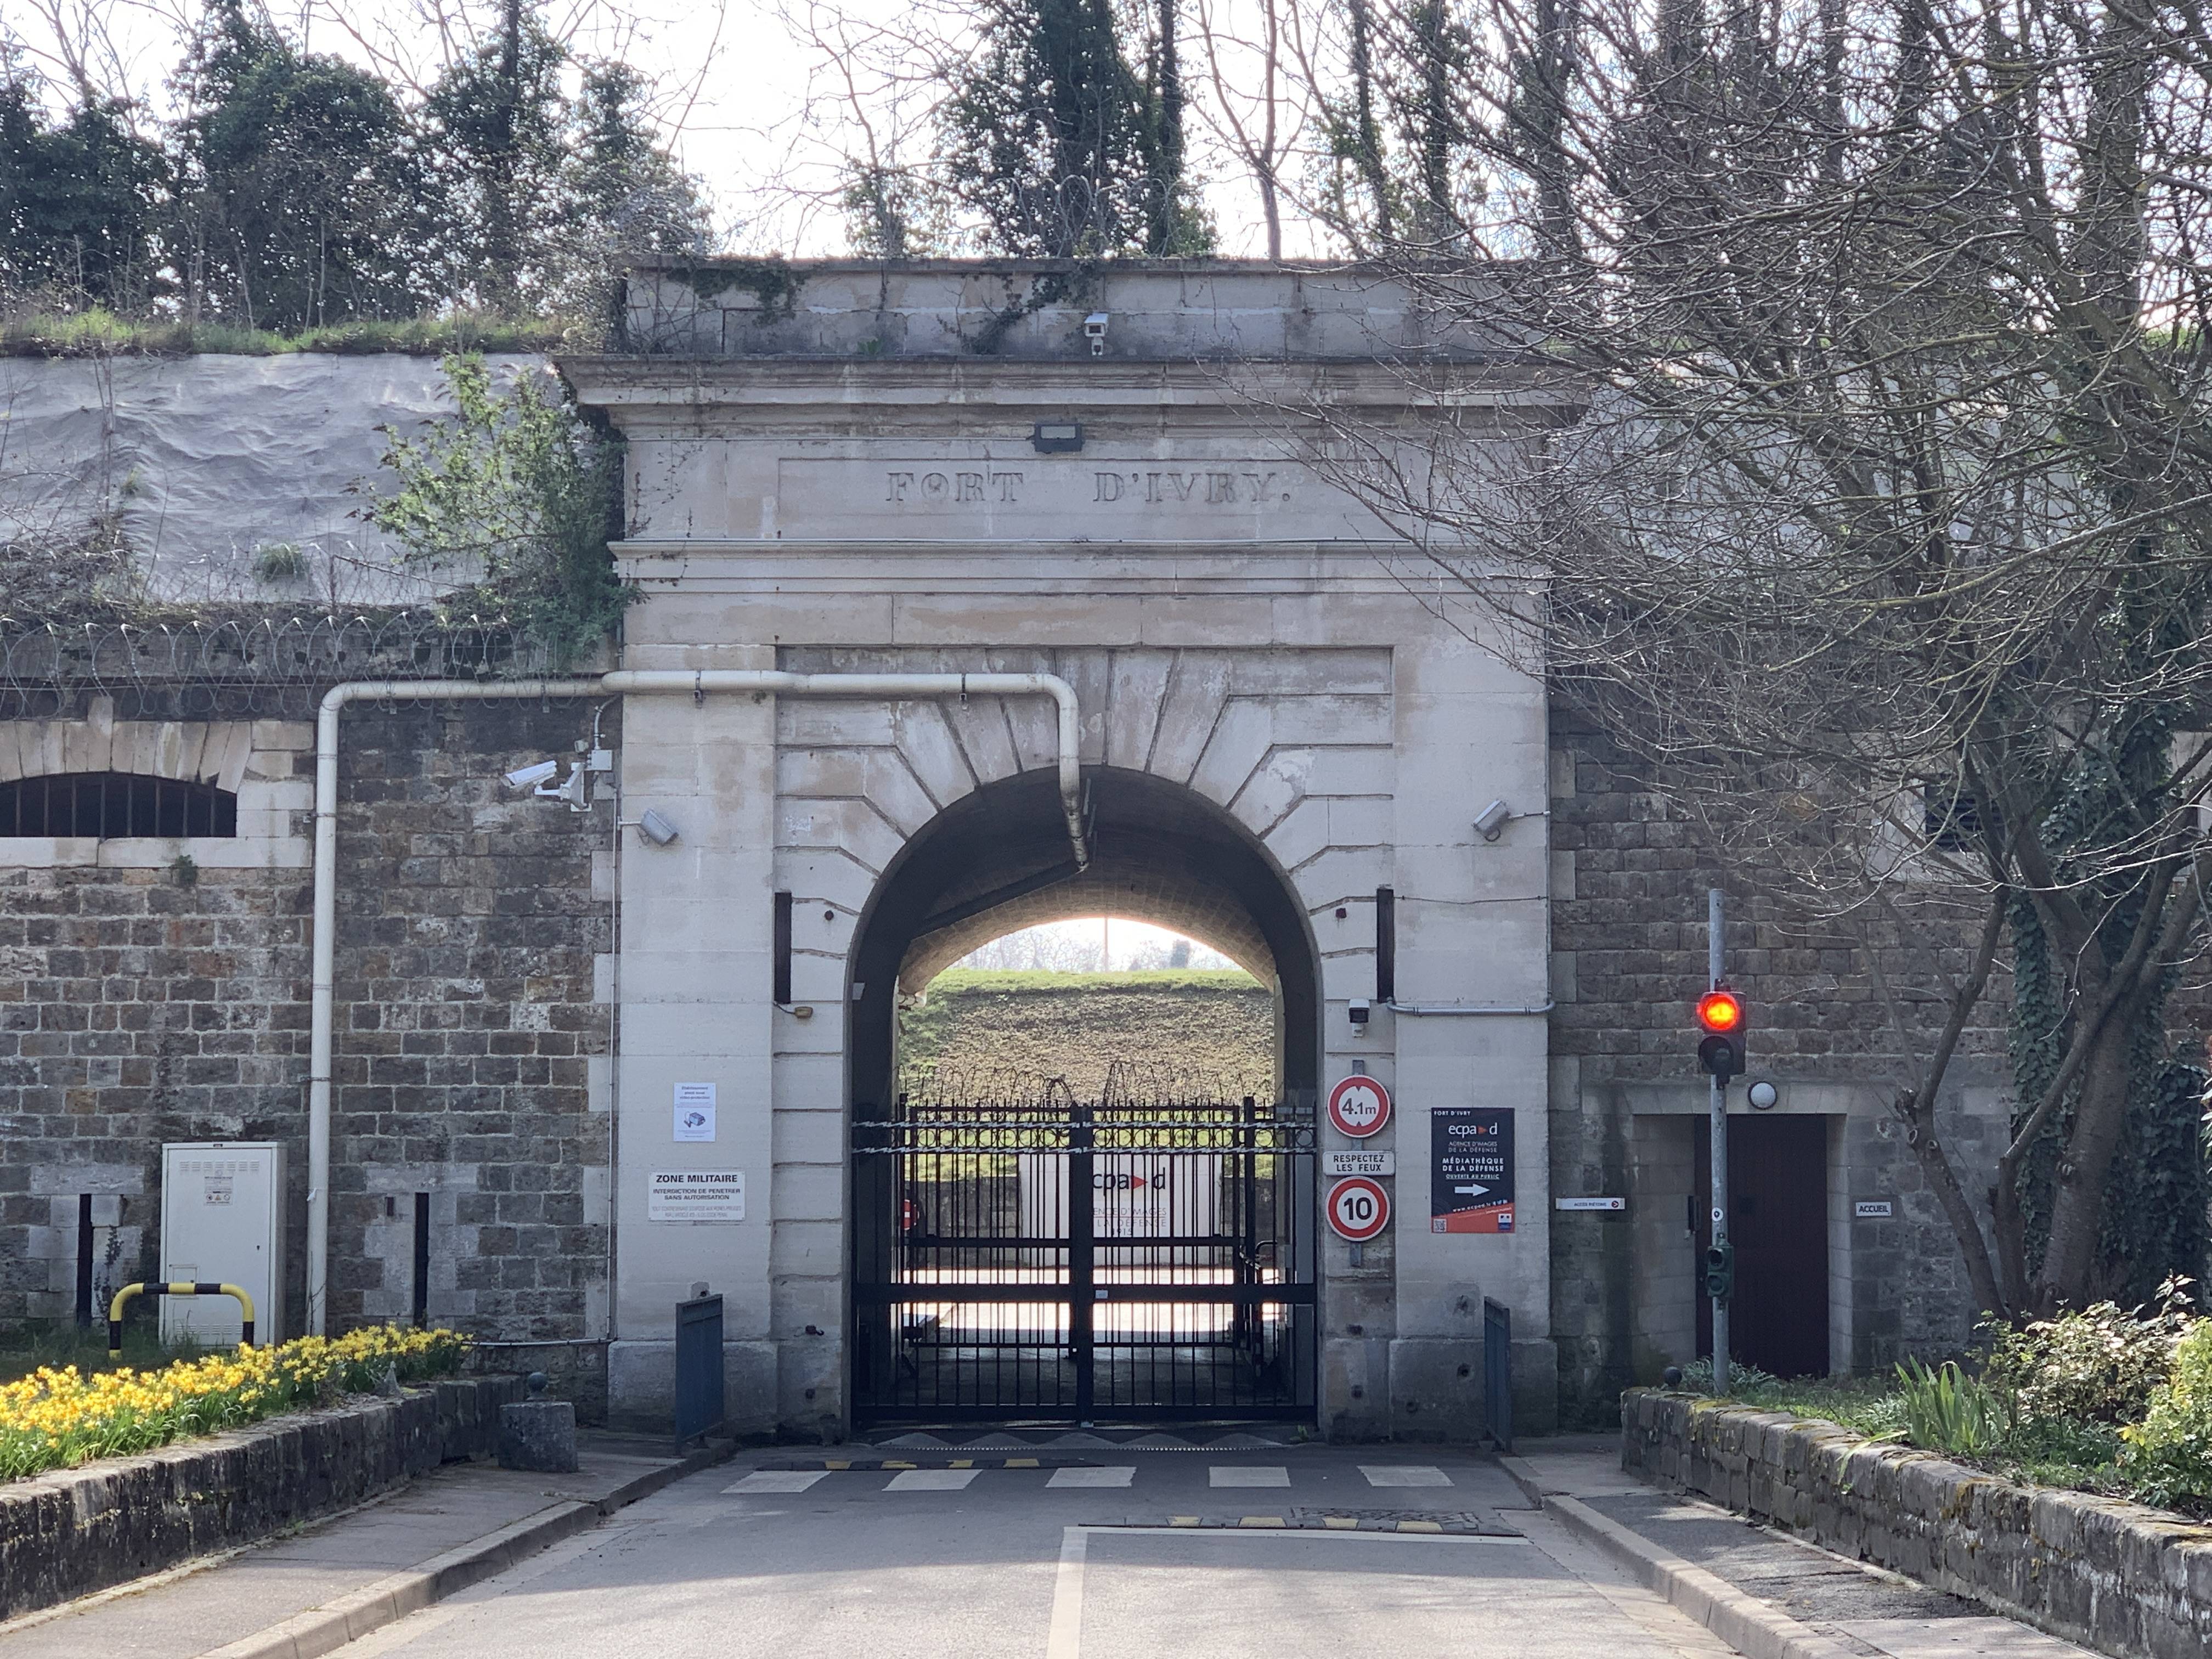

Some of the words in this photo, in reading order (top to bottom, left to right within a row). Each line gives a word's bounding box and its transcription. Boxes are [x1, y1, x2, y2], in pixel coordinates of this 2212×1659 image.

[885, 472, 1024, 502] FORT
[1333, 1154, 1385, 1163] RESPECTEZ
[1442, 1156, 1504, 1164] MÉDIATHÈQUE
[1336, 1164, 1353, 1172] LES
[1358, 1164, 1381, 1172] FEUX
[1469, 1164, 1504, 1172] DÉFENSE
[656, 1175, 684, 1183] ZONE
[687, 1175, 738, 1183] MILITAIRE
[1344, 1197, 1372, 1220] 10
